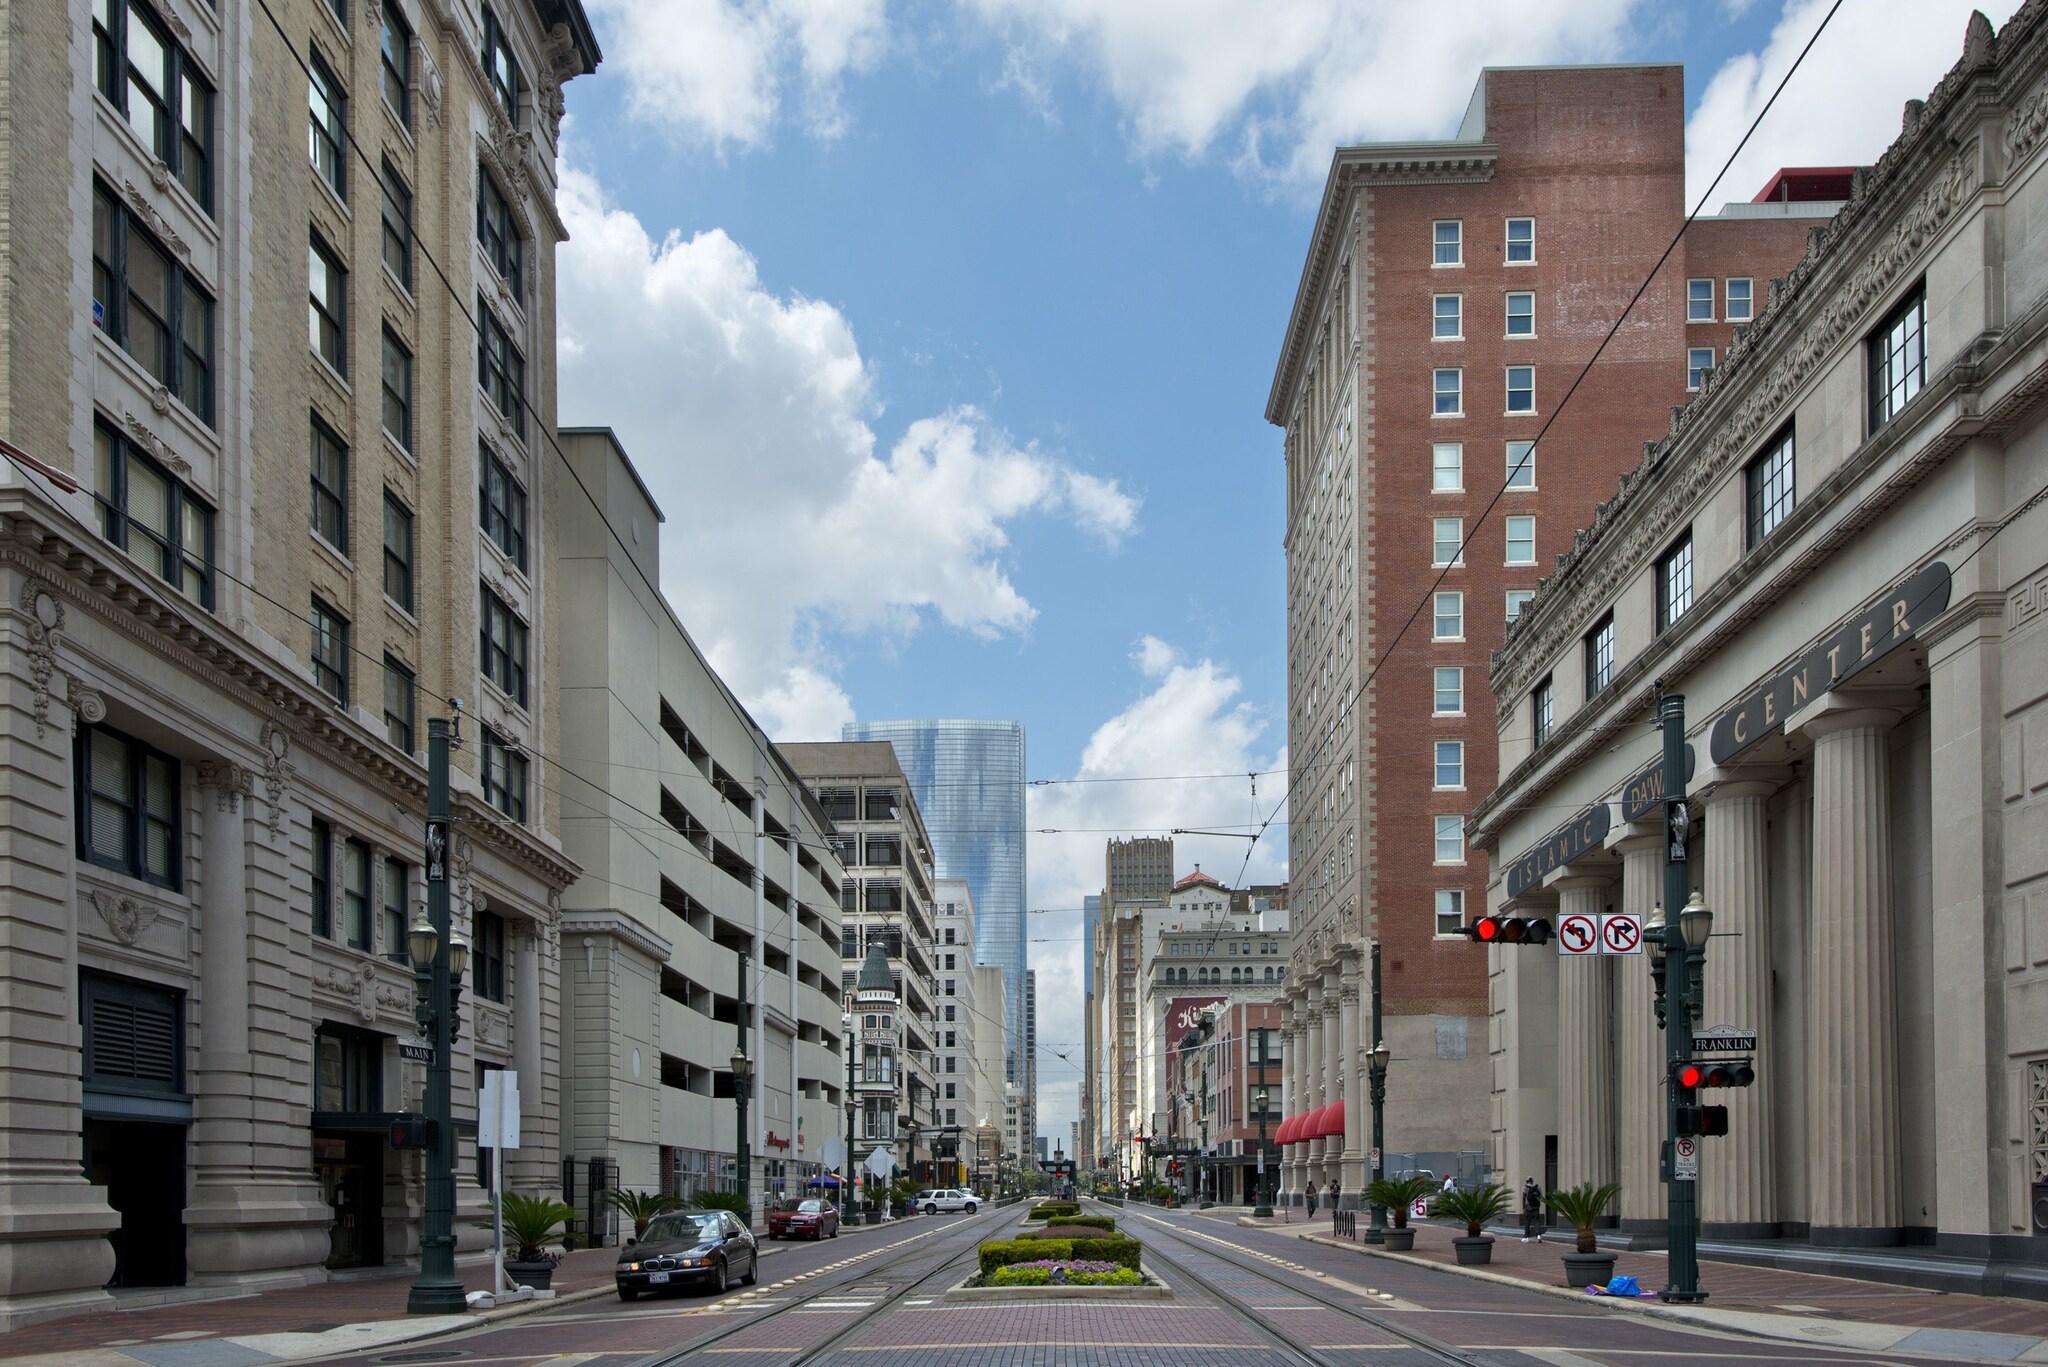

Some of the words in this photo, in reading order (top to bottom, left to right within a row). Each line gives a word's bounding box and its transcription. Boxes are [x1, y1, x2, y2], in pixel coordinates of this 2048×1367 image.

[1518, 820, 1592, 888] ISLAMIC
[1631, 769, 1665, 813] DA'W
[1734, 600, 1911, 743] CENTER
[1695, 1039, 1753, 1050] FRANKLIN
[405, 1047, 430, 1060] MAIN
